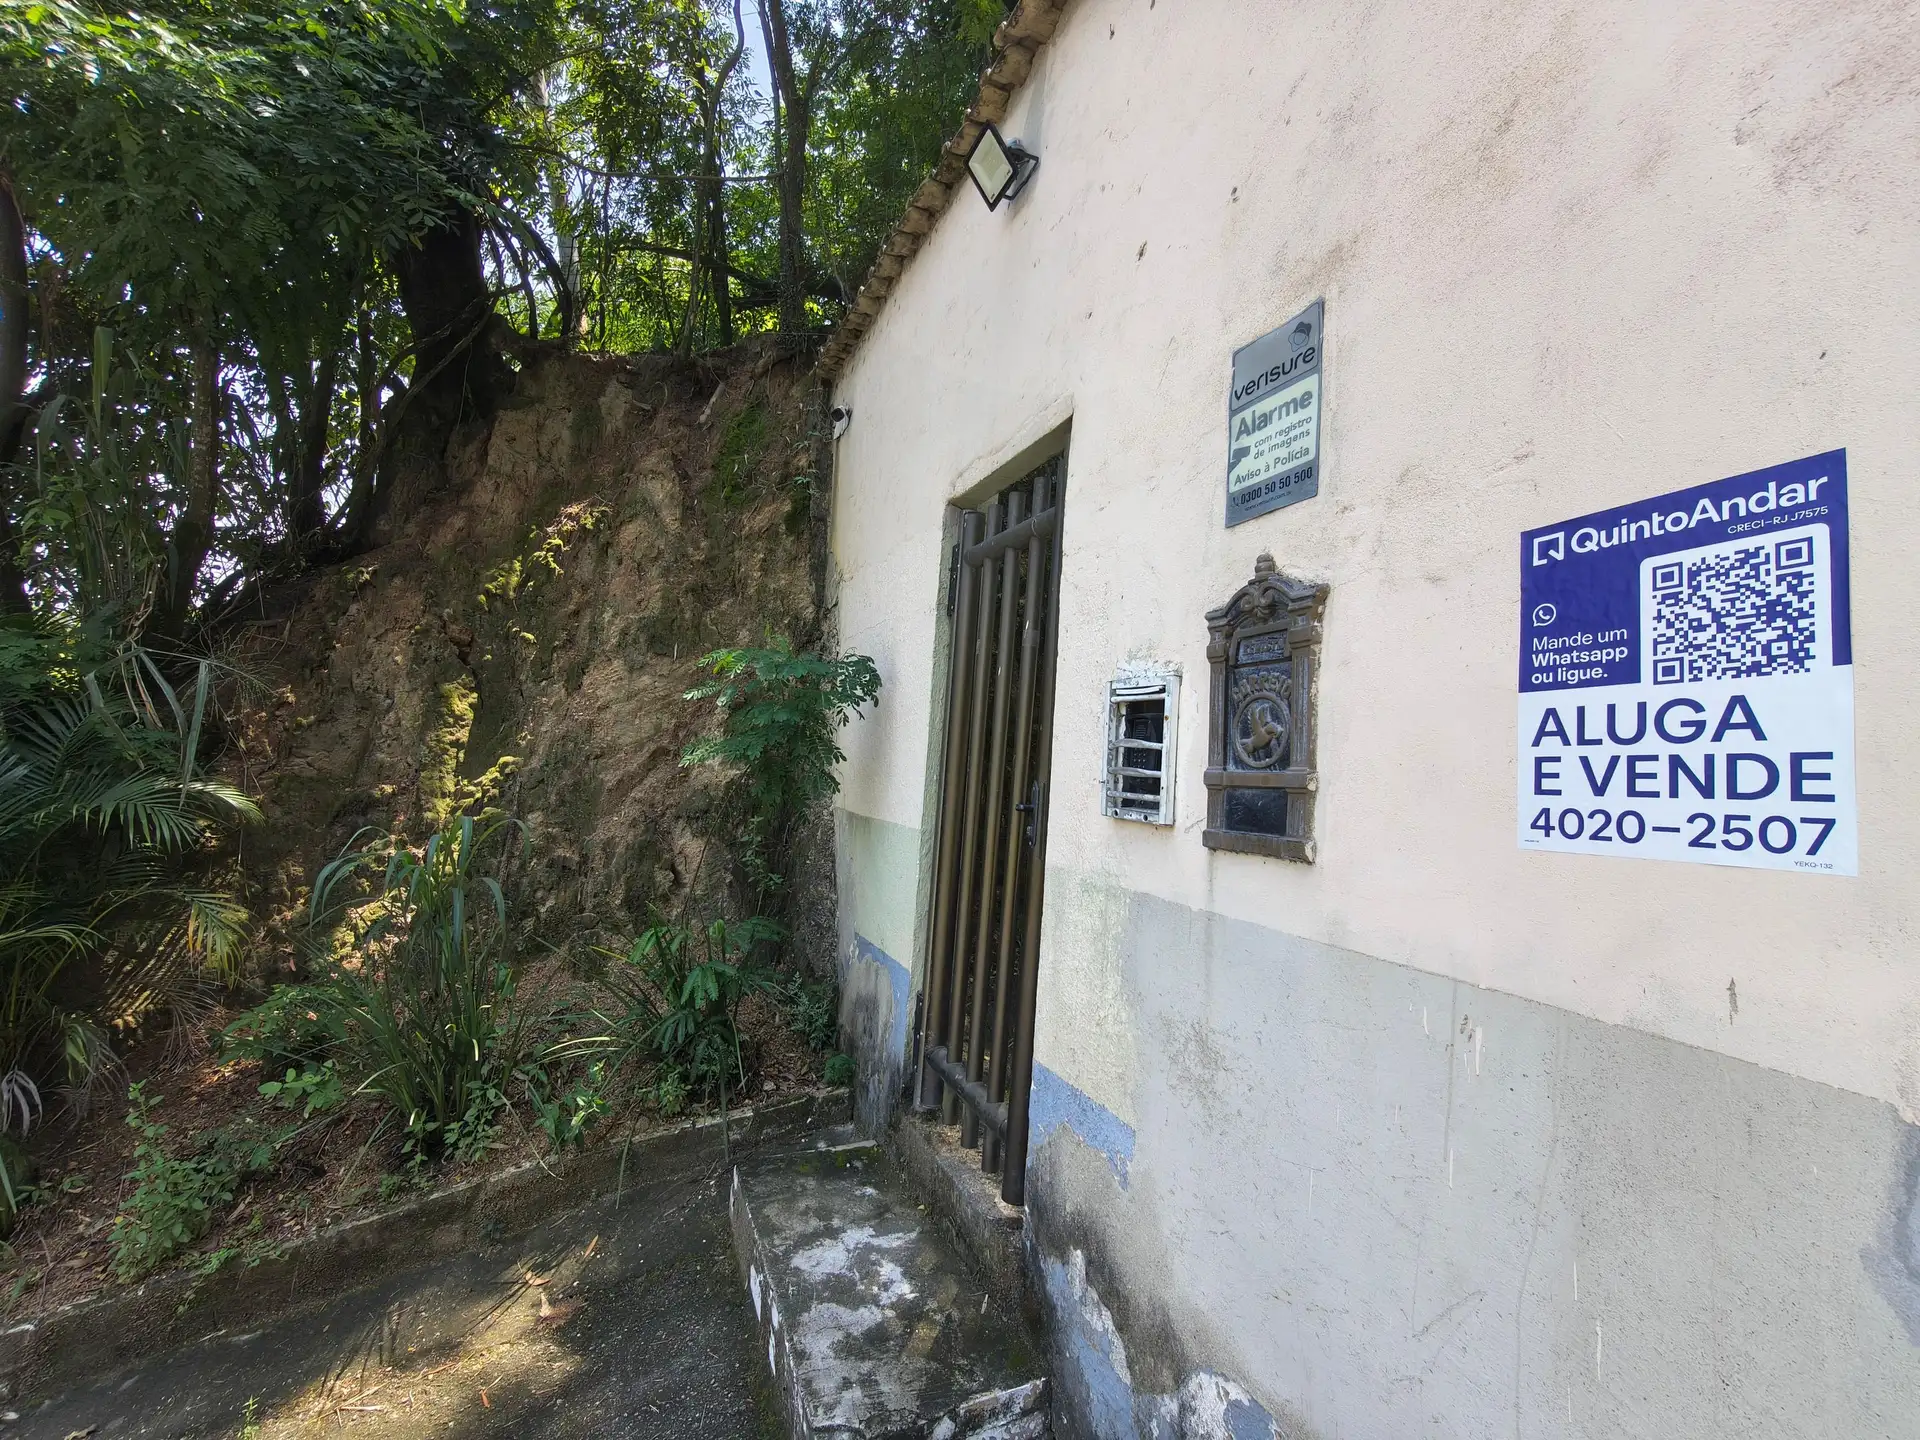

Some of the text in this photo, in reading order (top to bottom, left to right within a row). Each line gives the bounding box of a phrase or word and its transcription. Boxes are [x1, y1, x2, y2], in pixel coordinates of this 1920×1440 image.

[1234, 346, 1316, 401] verisure
[1235, 390, 1313, 442] Alarme
[1254, 416, 1312, 448] com registro
[1253, 428, 1311, 460] de imagens
[1233, 468, 1261, 487] Aviso
[1274, 446, 1310, 469] Polícia
[1240, 466, 1313, 505] 0300 50 50 500
[1570, 475, 1828, 553] QuintoAndar
[1727, 505, 1829, 534] CRECI-RJ J7575
[1531, 646, 1628, 668] Whatsapp
[1532, 628, 1628, 651] Mande um
[1531, 667, 1608, 684] ou ligue.
[1530, 694, 1768, 748] ALUGA
[1534, 751, 1836, 803] E VENDE
[1530, 807, 1837, 856] 4020-2507
